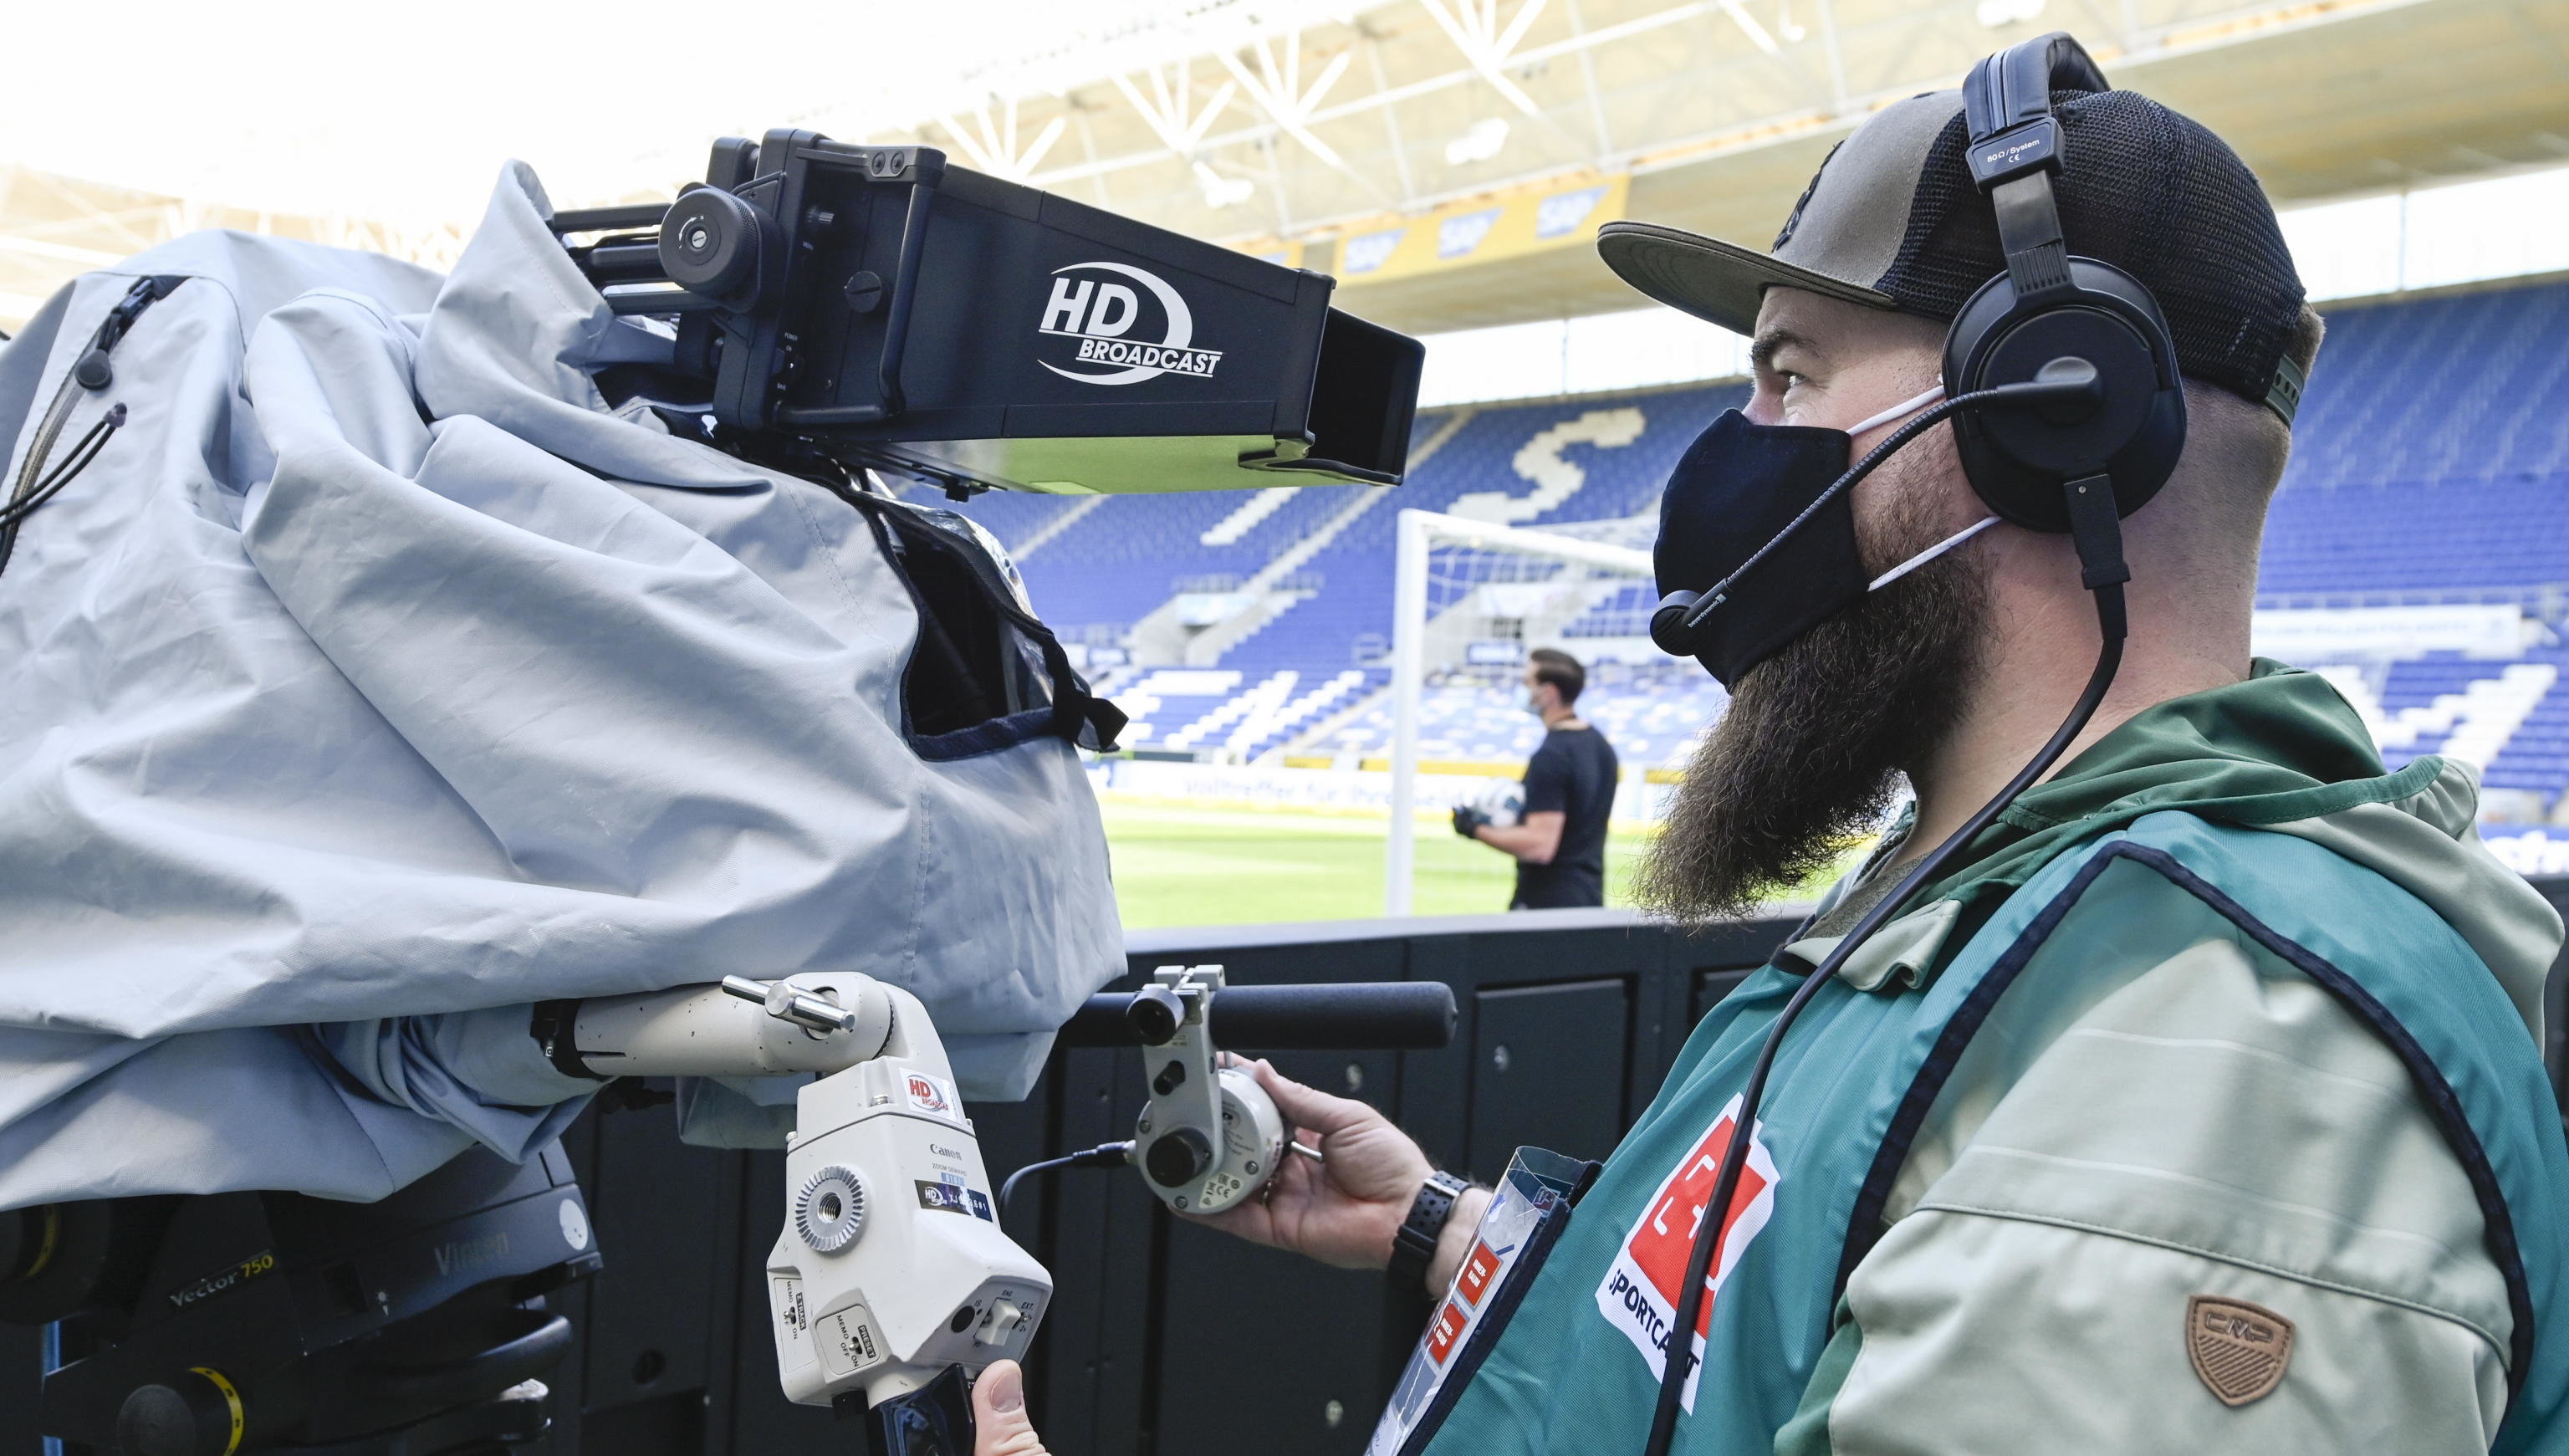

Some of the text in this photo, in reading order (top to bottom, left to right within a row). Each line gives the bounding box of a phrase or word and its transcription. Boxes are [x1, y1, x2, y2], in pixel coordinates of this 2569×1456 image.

[1040, 277, 1138, 338] HD
[1079, 339, 1222, 375] BROADCAST
[909, 1078, 931, 1097] HD
[930, 1143, 962, 1161] Canon
[170, 1254, 274, 1307] Vector 750
[792, 1327, 798, 1340] ON
[837, 1315, 849, 1339] MEMO
[2205, 1310, 2274, 1344] CMP
[840, 1342, 850, 1356] OFF
[859, 1326, 875, 1357] PRESET
[851, 1355, 859, 1367] ON
